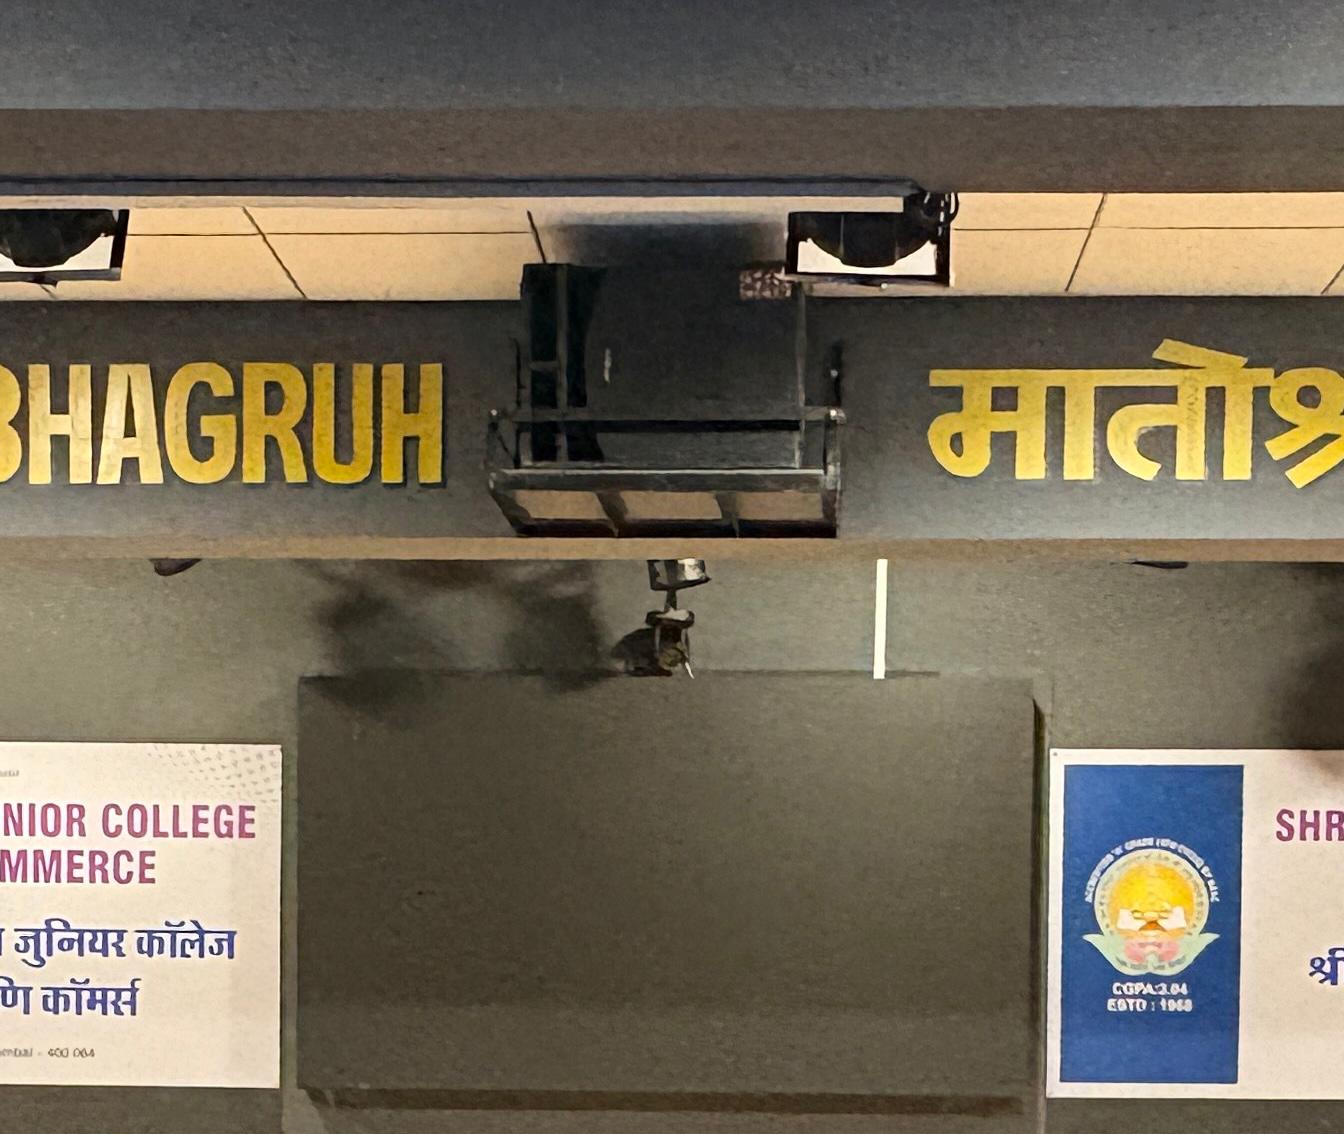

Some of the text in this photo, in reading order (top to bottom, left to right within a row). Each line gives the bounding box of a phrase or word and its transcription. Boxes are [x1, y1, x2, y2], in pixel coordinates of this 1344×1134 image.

[101, 802, 256, 840] COLLEGE
[13, 917, 129, 969] जुनियर
[133, 919, 238, 960] कॉलेज
[39, 976, 143, 1017] कॉमर्स
